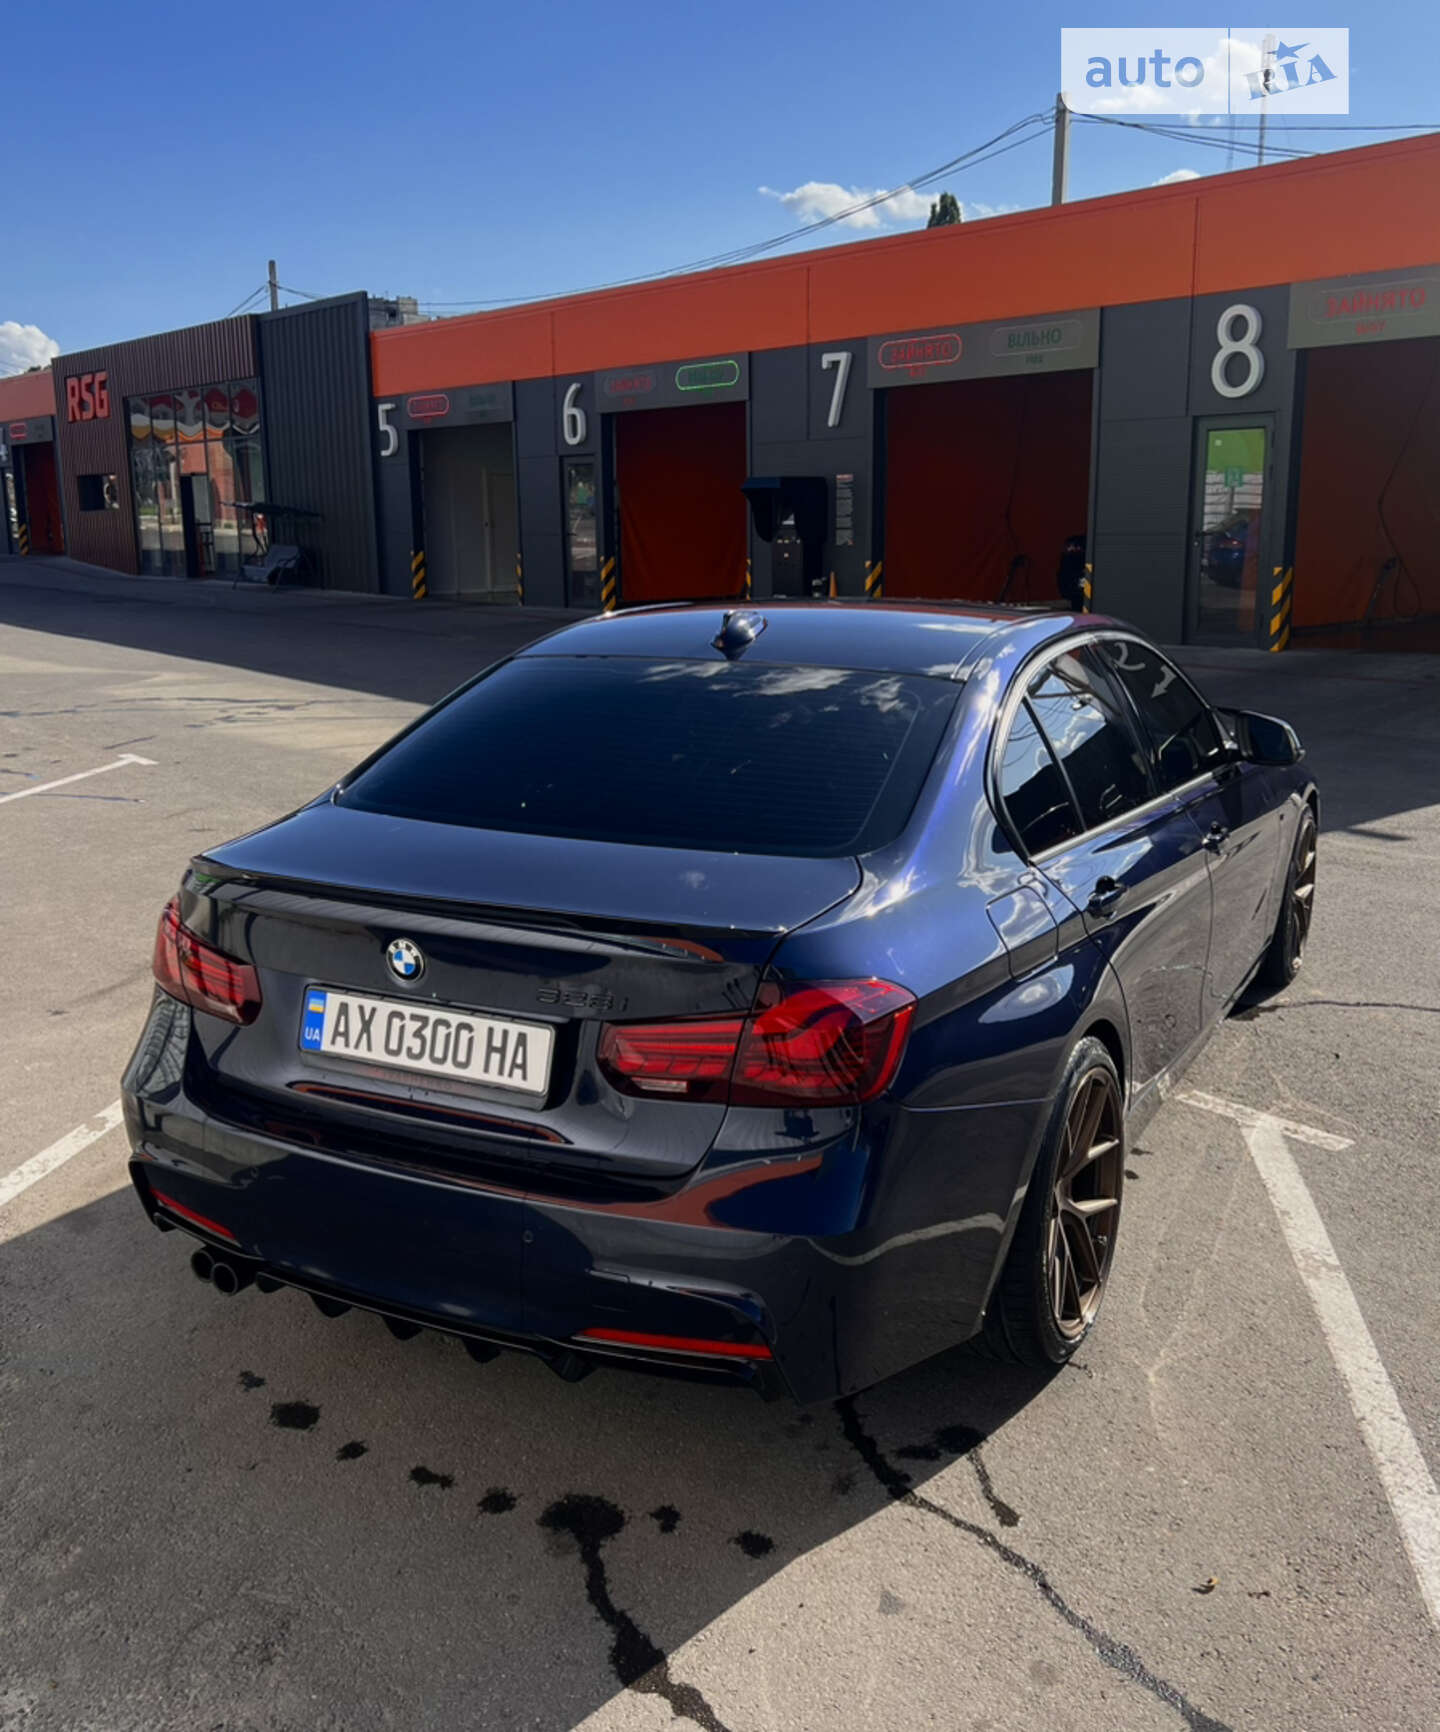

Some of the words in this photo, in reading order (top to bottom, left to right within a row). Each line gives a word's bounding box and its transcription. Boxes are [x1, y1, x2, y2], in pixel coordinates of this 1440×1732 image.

[1324, 287, 1427, 319] ЗАЙНЯТО
[1211, 303, 1265, 398] 8
[66, 371, 111, 423] RSG
[563, 382, 587, 446] 6
[821, 350, 852, 428] 7
[377, 402, 399, 457] 5
[304, 1026, 321, 1042] UA
[330, 1001, 377, 1052] AX
[384, 1009, 475, 1070] 0300
[483, 1026, 529, 1082] HA
